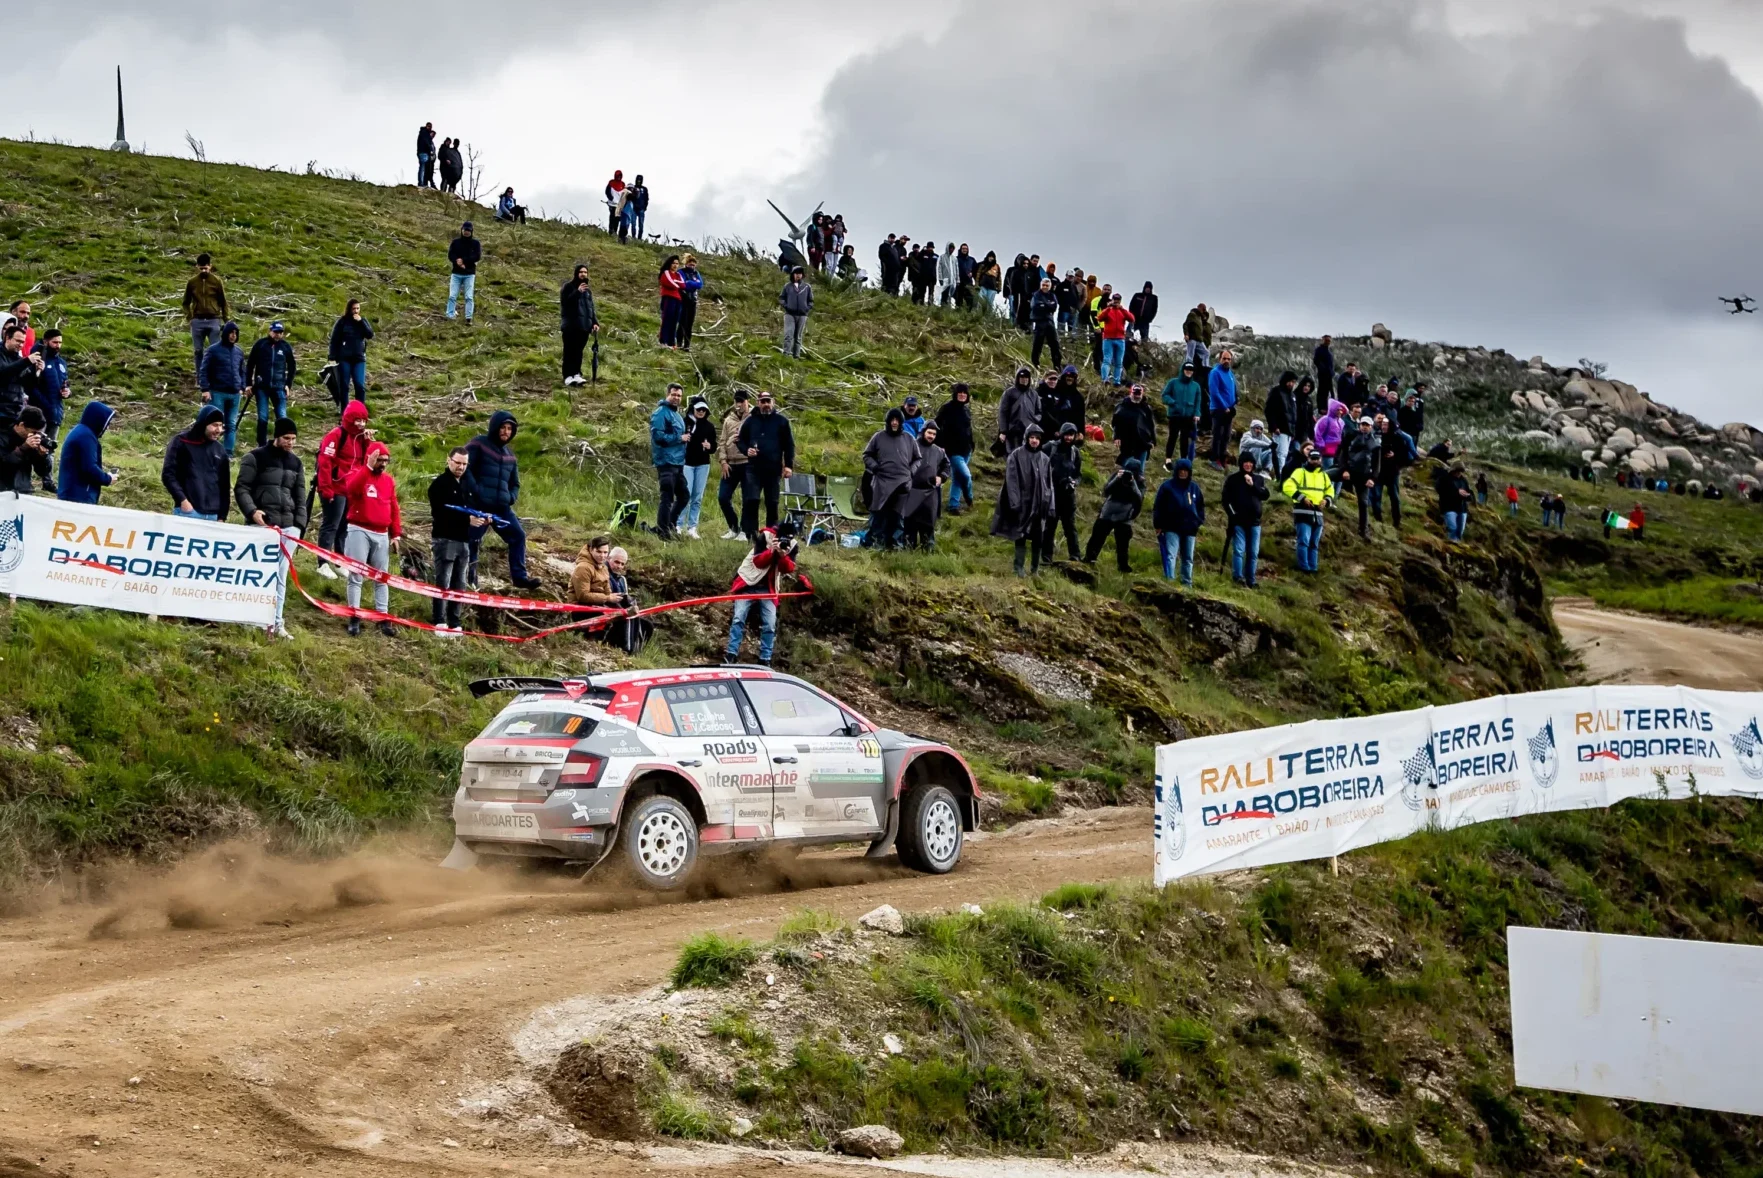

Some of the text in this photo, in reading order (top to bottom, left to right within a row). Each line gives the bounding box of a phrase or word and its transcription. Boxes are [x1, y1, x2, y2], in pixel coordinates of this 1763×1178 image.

[51, 520, 280, 563] RALI TERRAS
[46, 570, 108, 588] AMARANTE
[124, 579, 158, 595] BAIÃO
[172, 586, 207, 599] MARCO
[210, 589, 223, 600] DE
[562, 717, 583, 734] 10
[1576, 707, 1713, 735] RALI TERRAS
[861, 740, 880, 758] 10
[1201, 740, 1380, 795] RALI TERRAS
[1206, 828, 1263, 851] AMARANTE
[1276, 818, 1309, 836] BAIÃO
